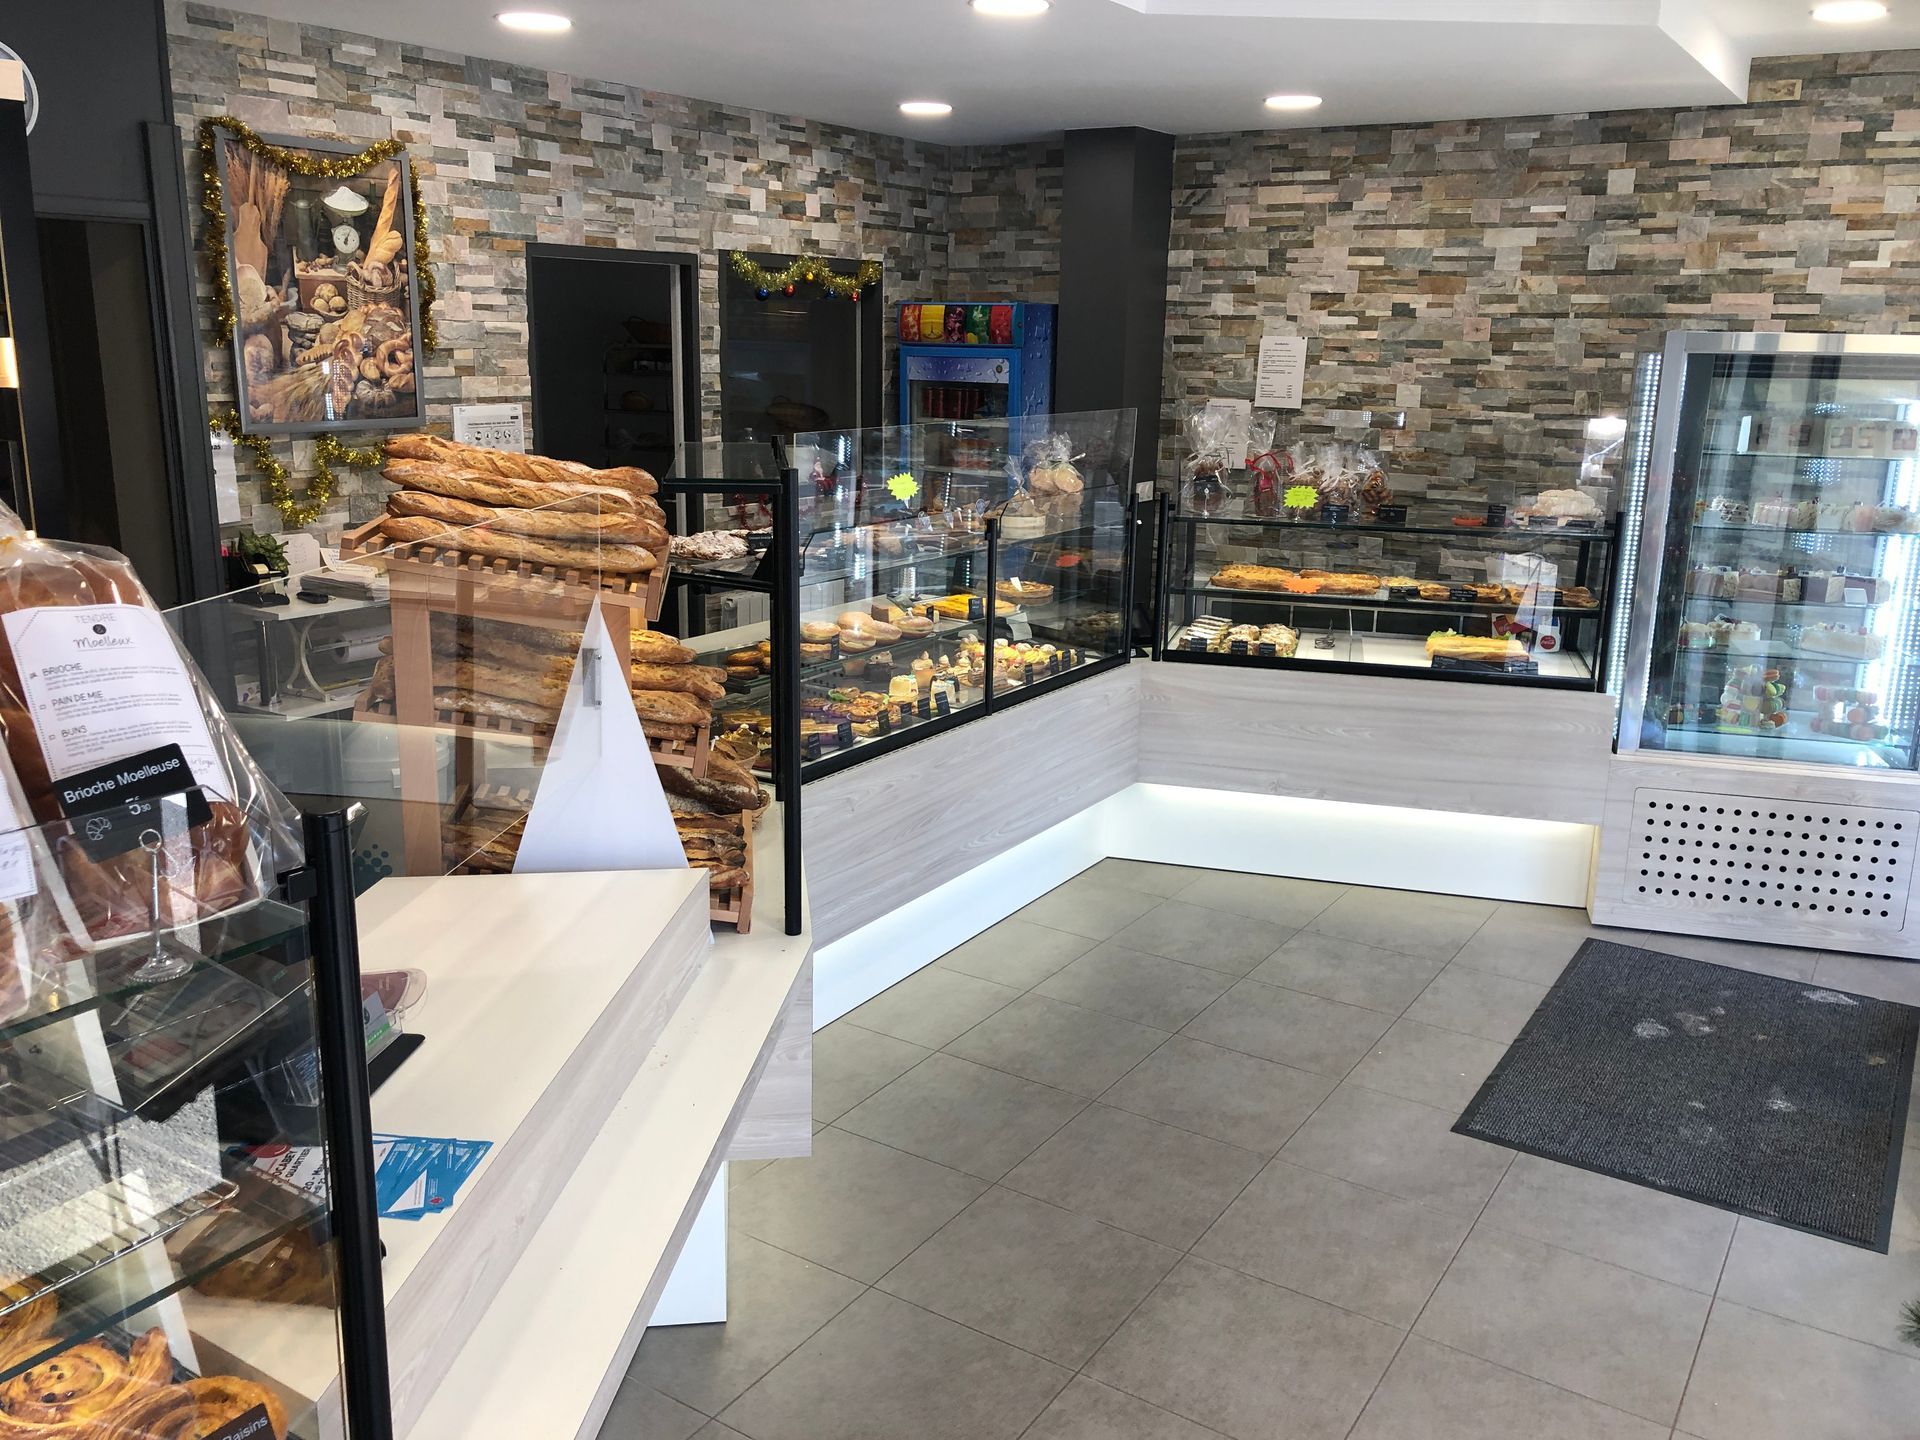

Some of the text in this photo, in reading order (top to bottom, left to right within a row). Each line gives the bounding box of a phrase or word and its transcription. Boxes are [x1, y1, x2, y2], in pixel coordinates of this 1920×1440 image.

[73, 612, 118, 624] TENDRE
[73, 637, 133, 649] Moelleux
[42, 663, 83, 676] BRIOCHE
[51, 690, 103, 707] PAIN DE MIE
[61, 725, 88, 738] BUNS
[63, 778, 116, 803] Brioche
[116, 757, 181, 787] Moelleuse
